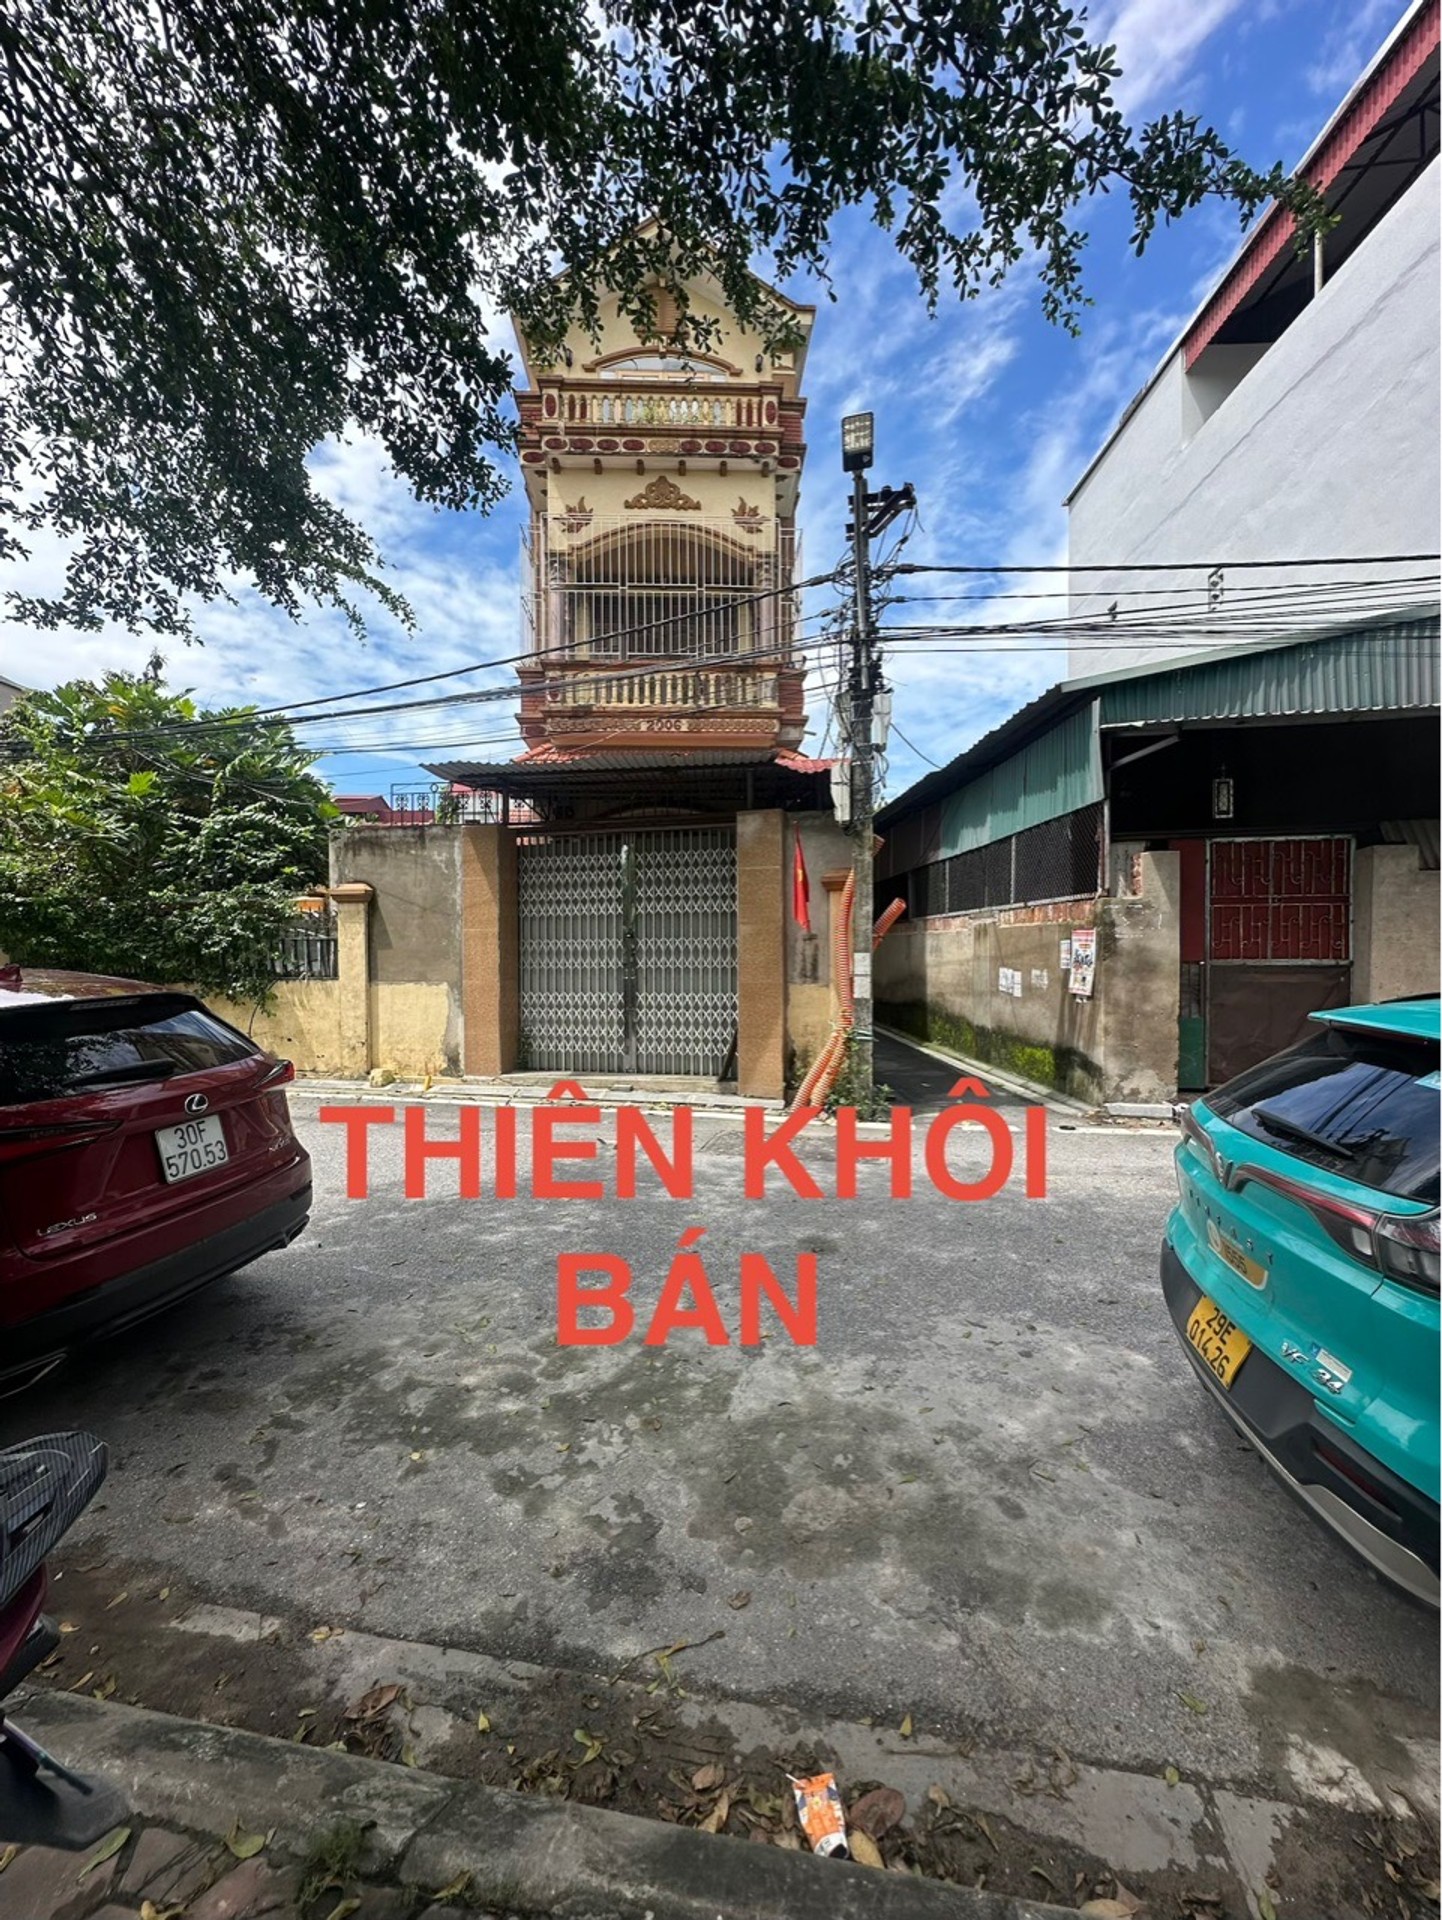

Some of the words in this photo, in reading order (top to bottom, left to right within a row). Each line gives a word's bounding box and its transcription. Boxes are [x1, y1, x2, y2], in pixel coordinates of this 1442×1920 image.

[174, 1120, 206, 1149] 30F
[165, 1140, 226, 1178] 570.53
[37, 1212, 98, 1236] LEXUS
[1206, 1307, 1236, 1346] 29E
